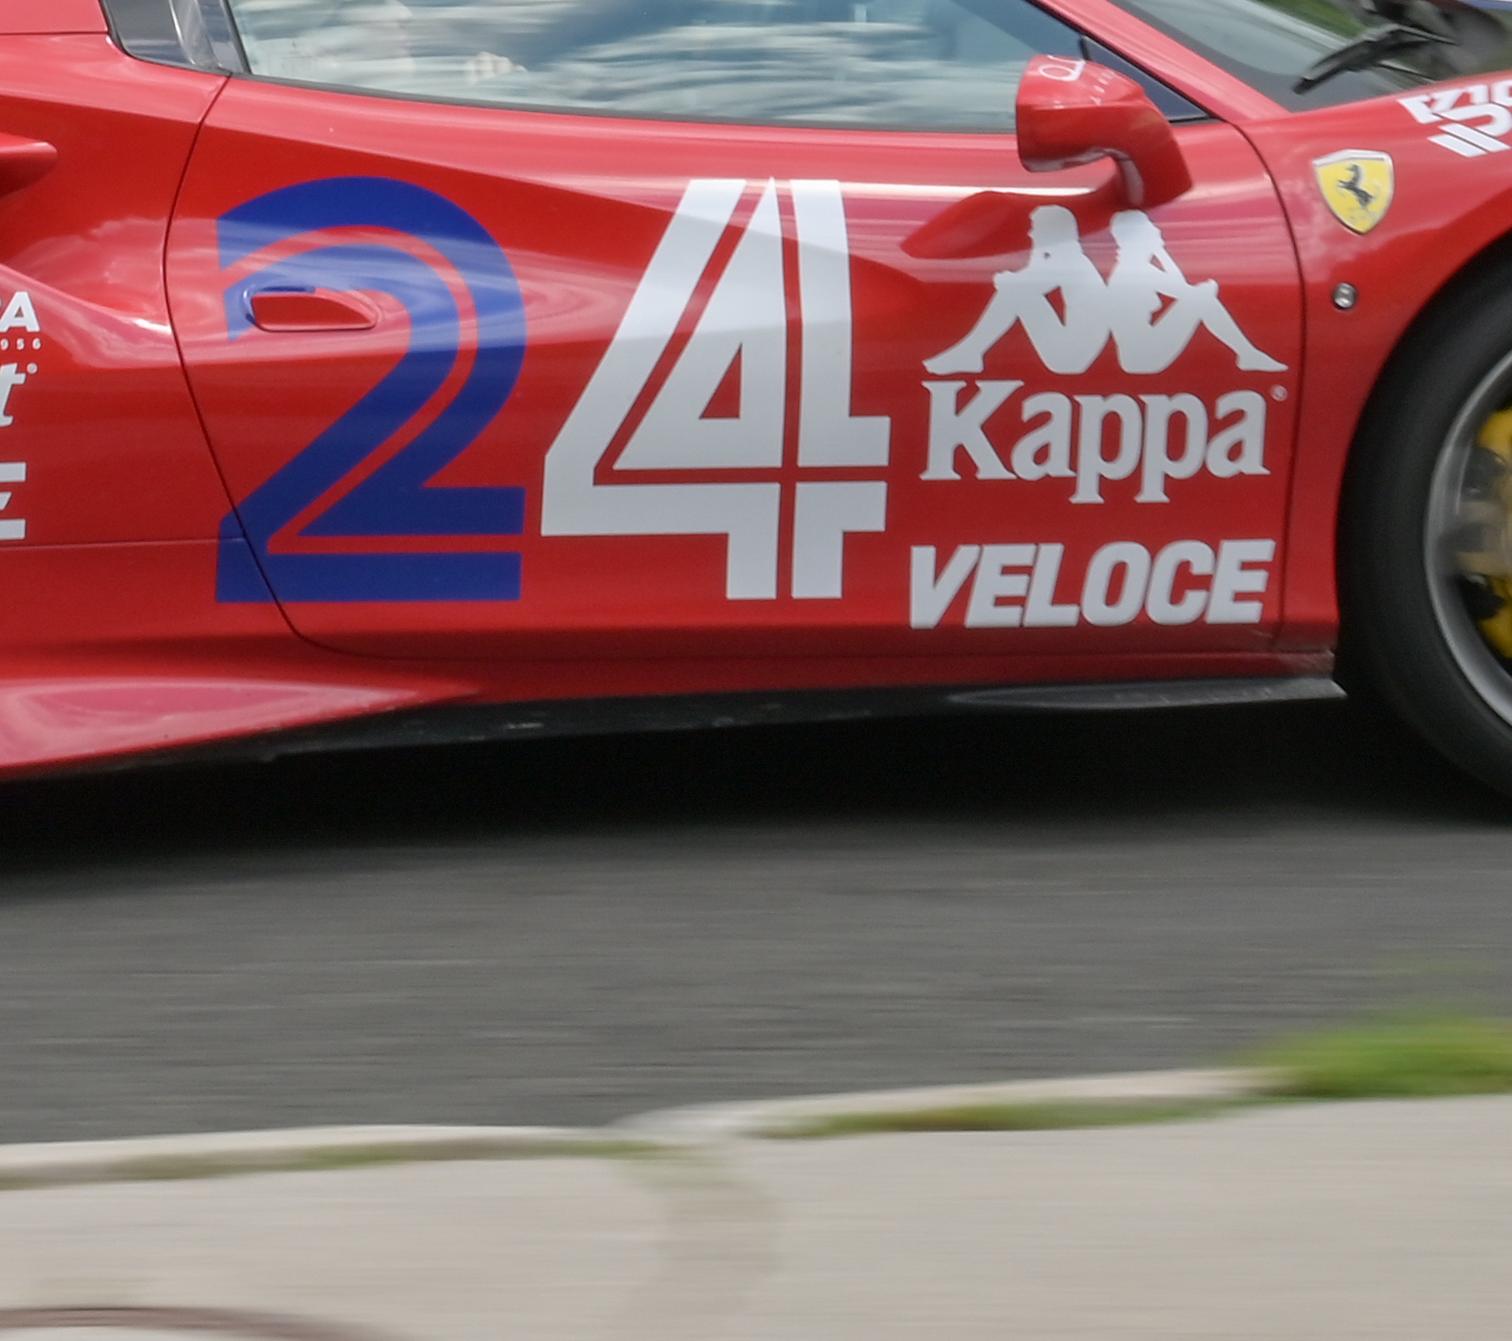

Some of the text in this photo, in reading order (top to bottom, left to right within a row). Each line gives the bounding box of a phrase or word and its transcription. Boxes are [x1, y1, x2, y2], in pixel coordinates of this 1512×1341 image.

[216, 176, 891, 603] 24
[919, 380, 1271, 503] Kappa
[910, 539, 1275, 629] VELOCE
